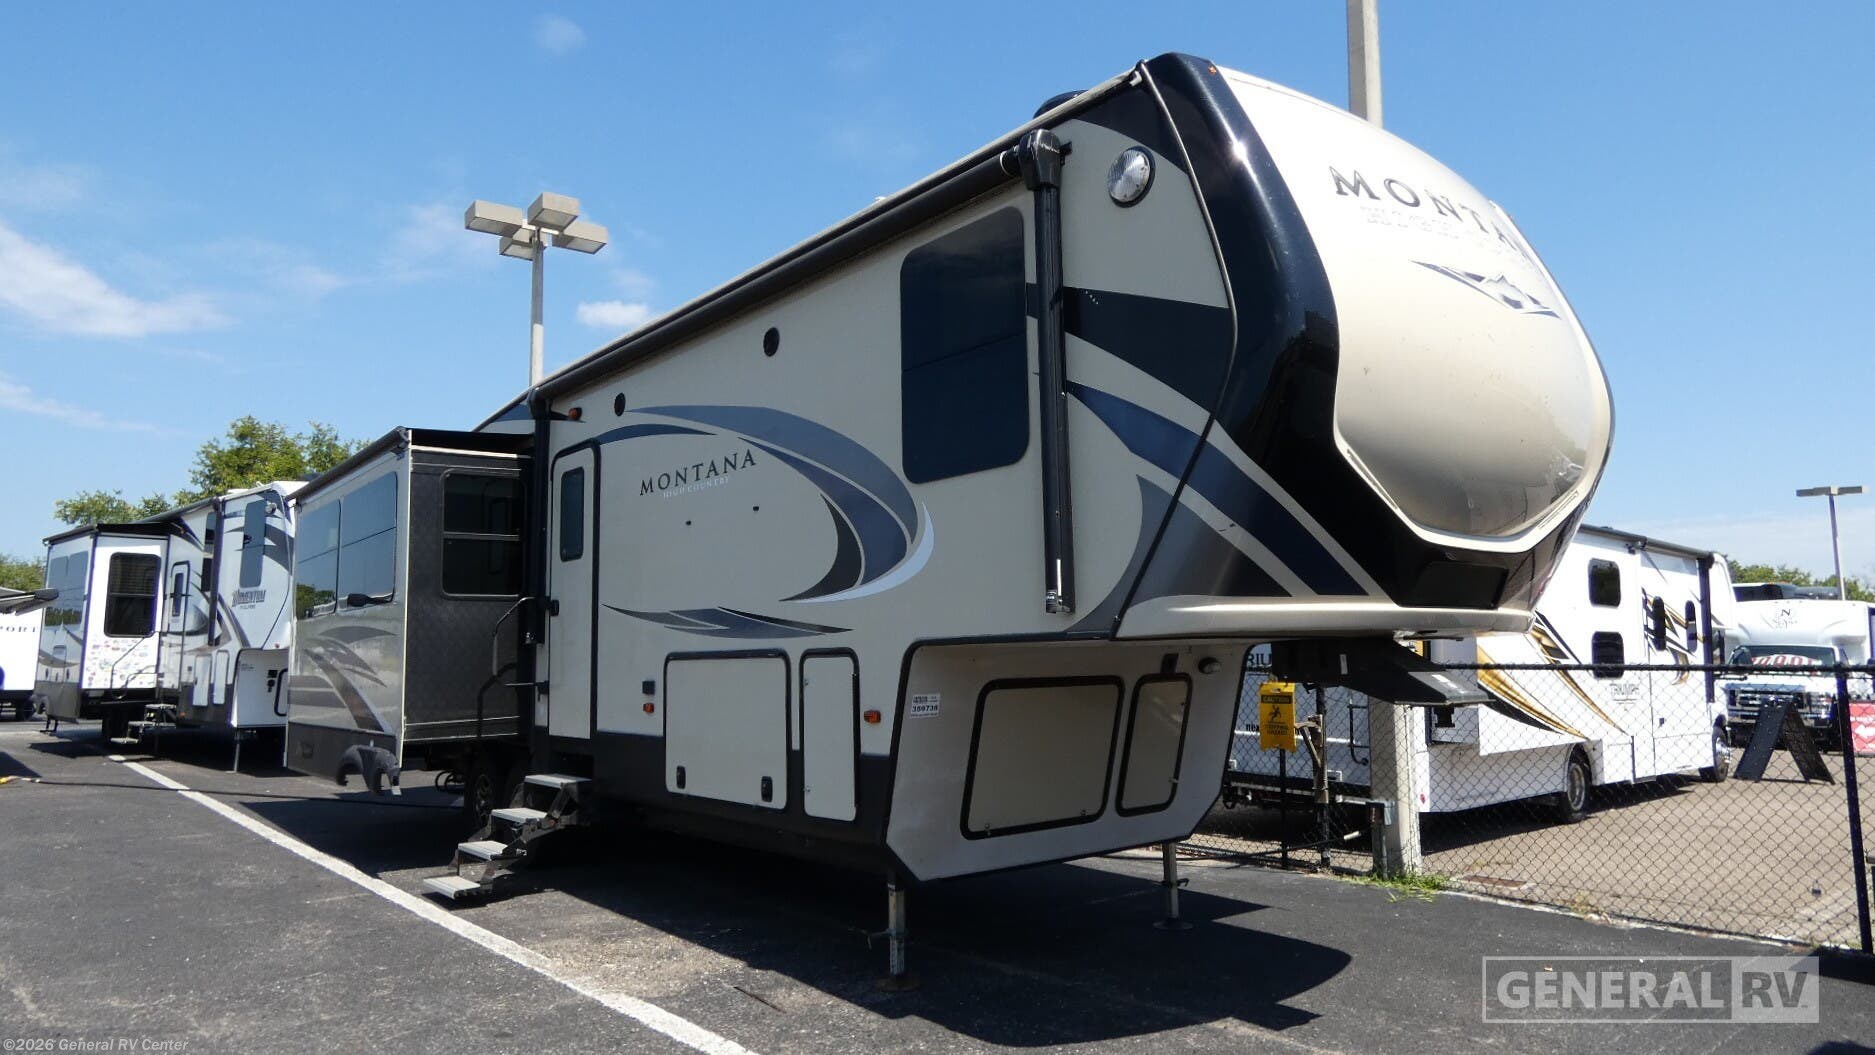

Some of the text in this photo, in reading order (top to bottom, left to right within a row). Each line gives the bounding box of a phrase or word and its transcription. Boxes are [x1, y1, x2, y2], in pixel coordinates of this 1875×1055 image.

[1329, 166, 1518, 252] MONTA
[640, 449, 757, 496] MONTANA
[1262, 696, 1290, 704] CAUTION
